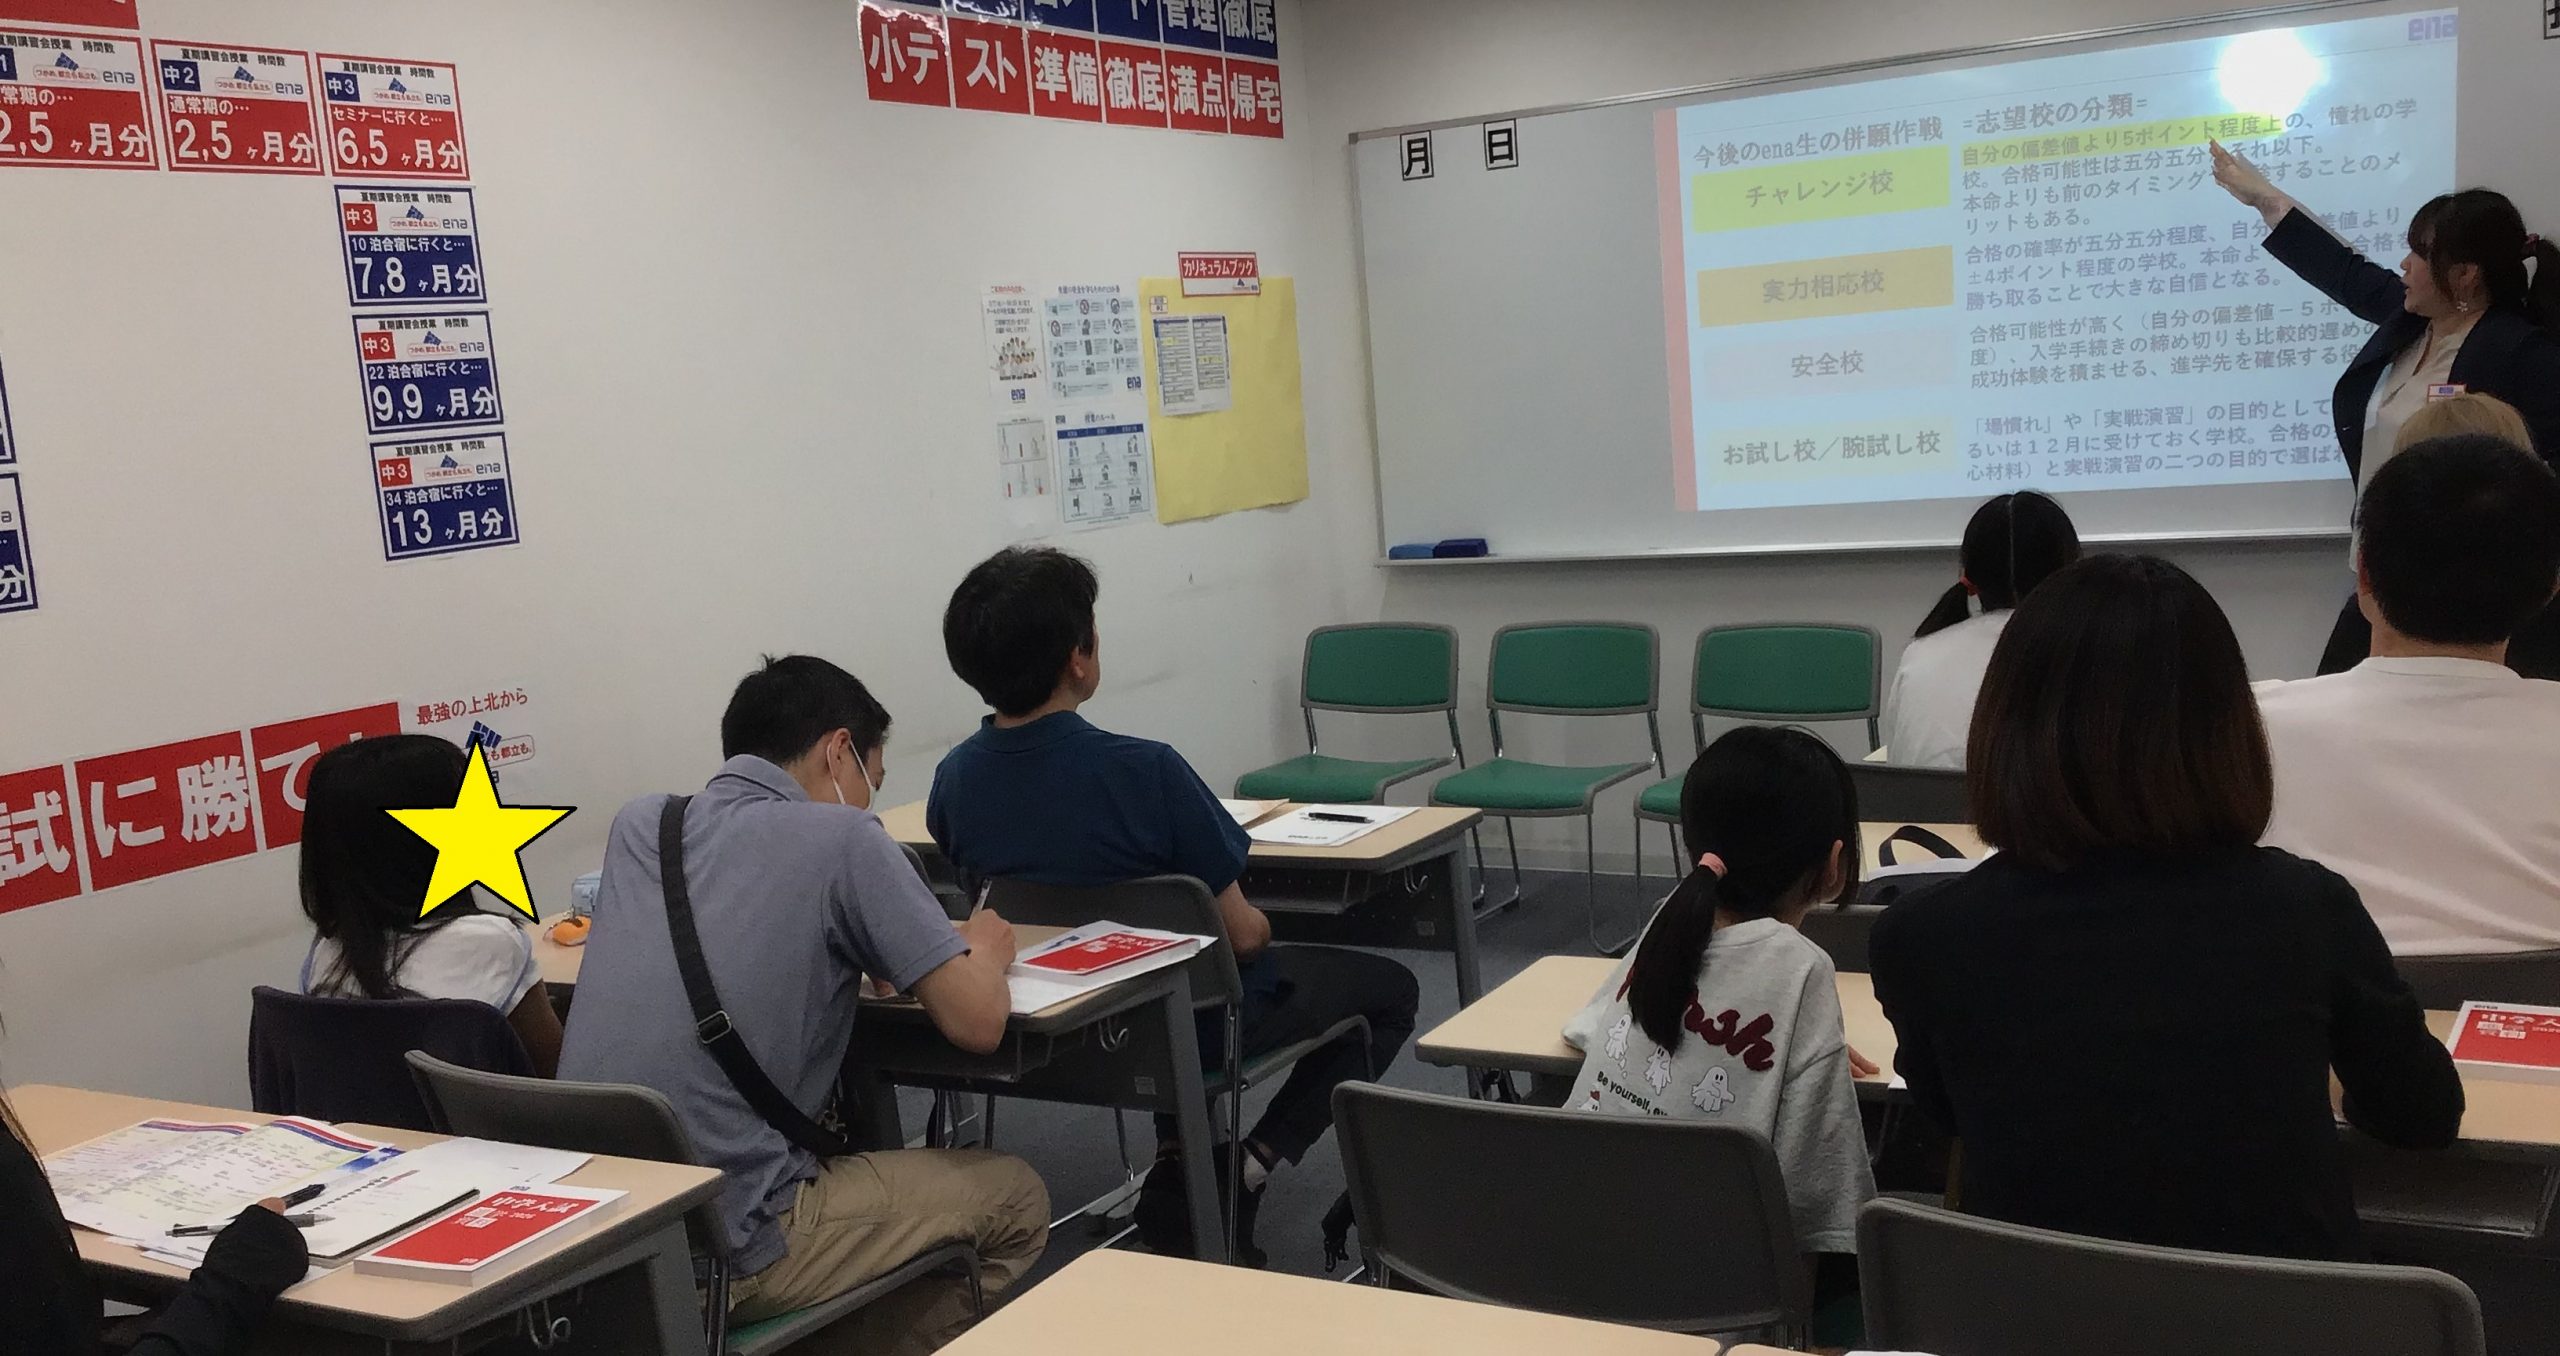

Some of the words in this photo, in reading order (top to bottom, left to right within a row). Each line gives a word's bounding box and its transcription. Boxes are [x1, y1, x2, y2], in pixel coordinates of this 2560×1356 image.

[2408, 14, 2458, 41] ena
[103, 70, 136, 84] ena
[164, 65, 196, 85] 中2
[275, 82, 304, 95] ena
[328, 77, 356, 96] 中3
[425, 92, 452, 105] ena
[1404, 136, 1431, 177] 月
[1487, 127, 1514, 165] 日
[1694, 116, 1943, 169] 今後のena生の併願作戦
[1745, 168, 1894, 208] チャレンジ校
[347, 208, 373, 225] 中3
[442, 218, 468, 230] ena
[1967, 208, 2091, 235] リットもある。
[1183, 259, 1254, 276] カリキュラムブック
[1762, 269, 1886, 303] 実力相応校
[364, 337, 390, 355] 中3
[459, 341, 485, 353] ena
[1791, 350, 1864, 378] 安全校
[1723, 430, 1941, 466] お試し校／腕試し校
[1968, 422, 2338, 460] るいは12月に受けておく学校。合格の
[381, 463, 408, 481] 中3
[475, 462, 501, 475] ena
[393, 508, 433, 547] 13
[416, 687, 528, 725] 最強の上北から
[1597, 1070, 1609, 1087] Be
